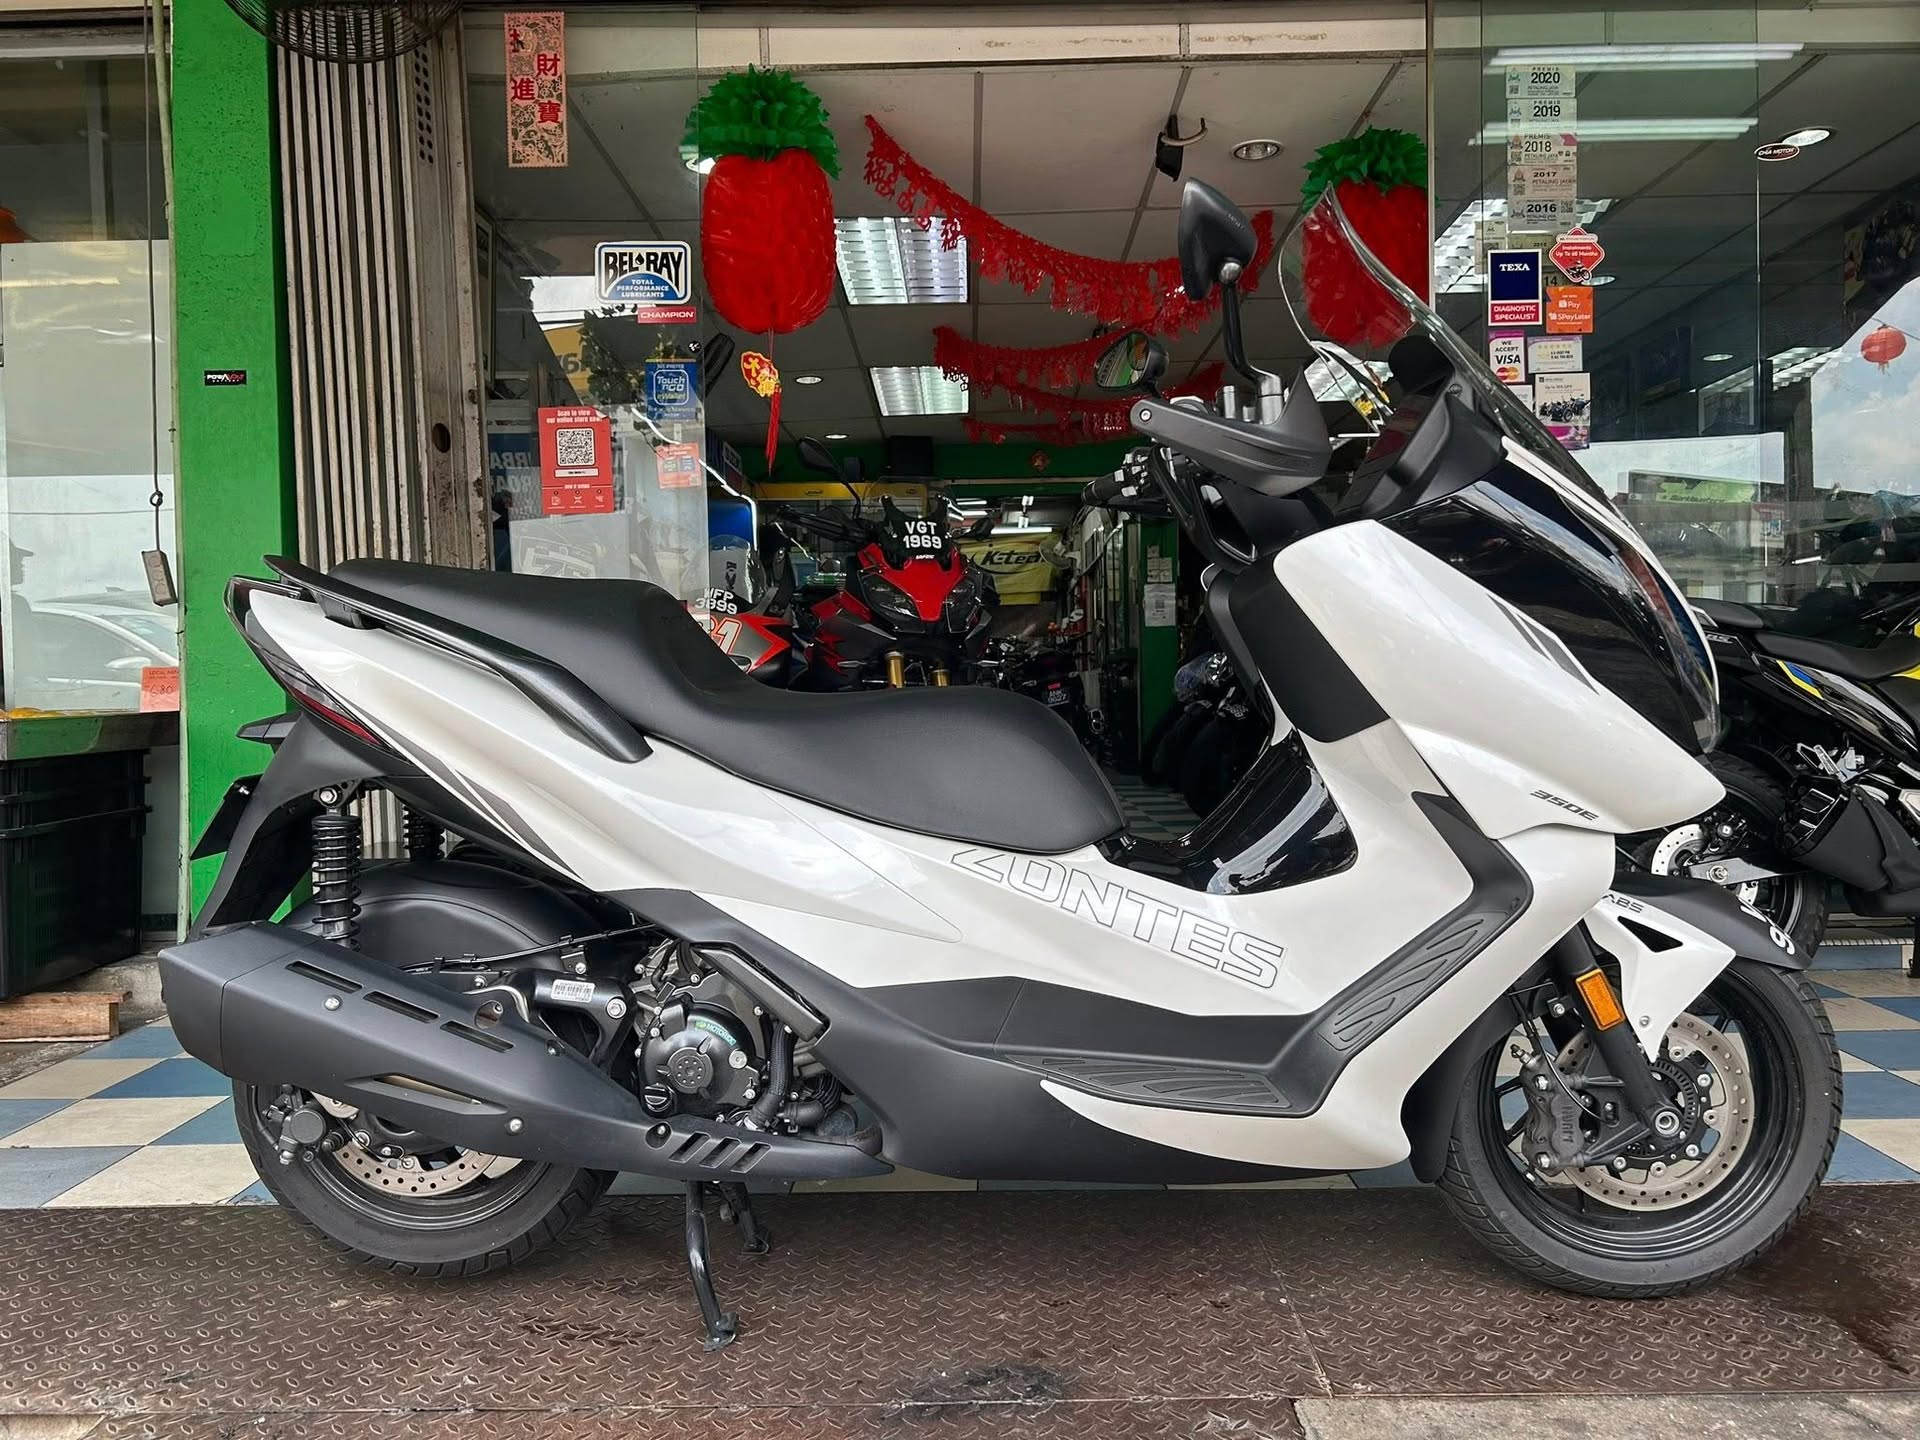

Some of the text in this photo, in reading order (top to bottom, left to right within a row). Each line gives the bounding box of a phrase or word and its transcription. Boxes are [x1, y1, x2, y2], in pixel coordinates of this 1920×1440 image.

[1531, 72, 1560, 84] 2020
[1533, 105, 1561, 118] 2019
[1524, 141, 1552, 153] 2018
[1527, 203, 1557, 213] 2016
[1499, 263, 1530, 271] TEXA
[640, 311, 694, 319] CHAMPION
[1495, 354, 1520, 365] VISA
[657, 376, 685, 384] Touch
[905, 521, 937, 535] VGT
[903, 535, 942, 549] 1969
[695, 598, 738, 615] 3899
[1530, 789, 1599, 821] 350E
[1601, 894, 1644, 913] ABS
[951, 848, 1285, 989] ZONTES
